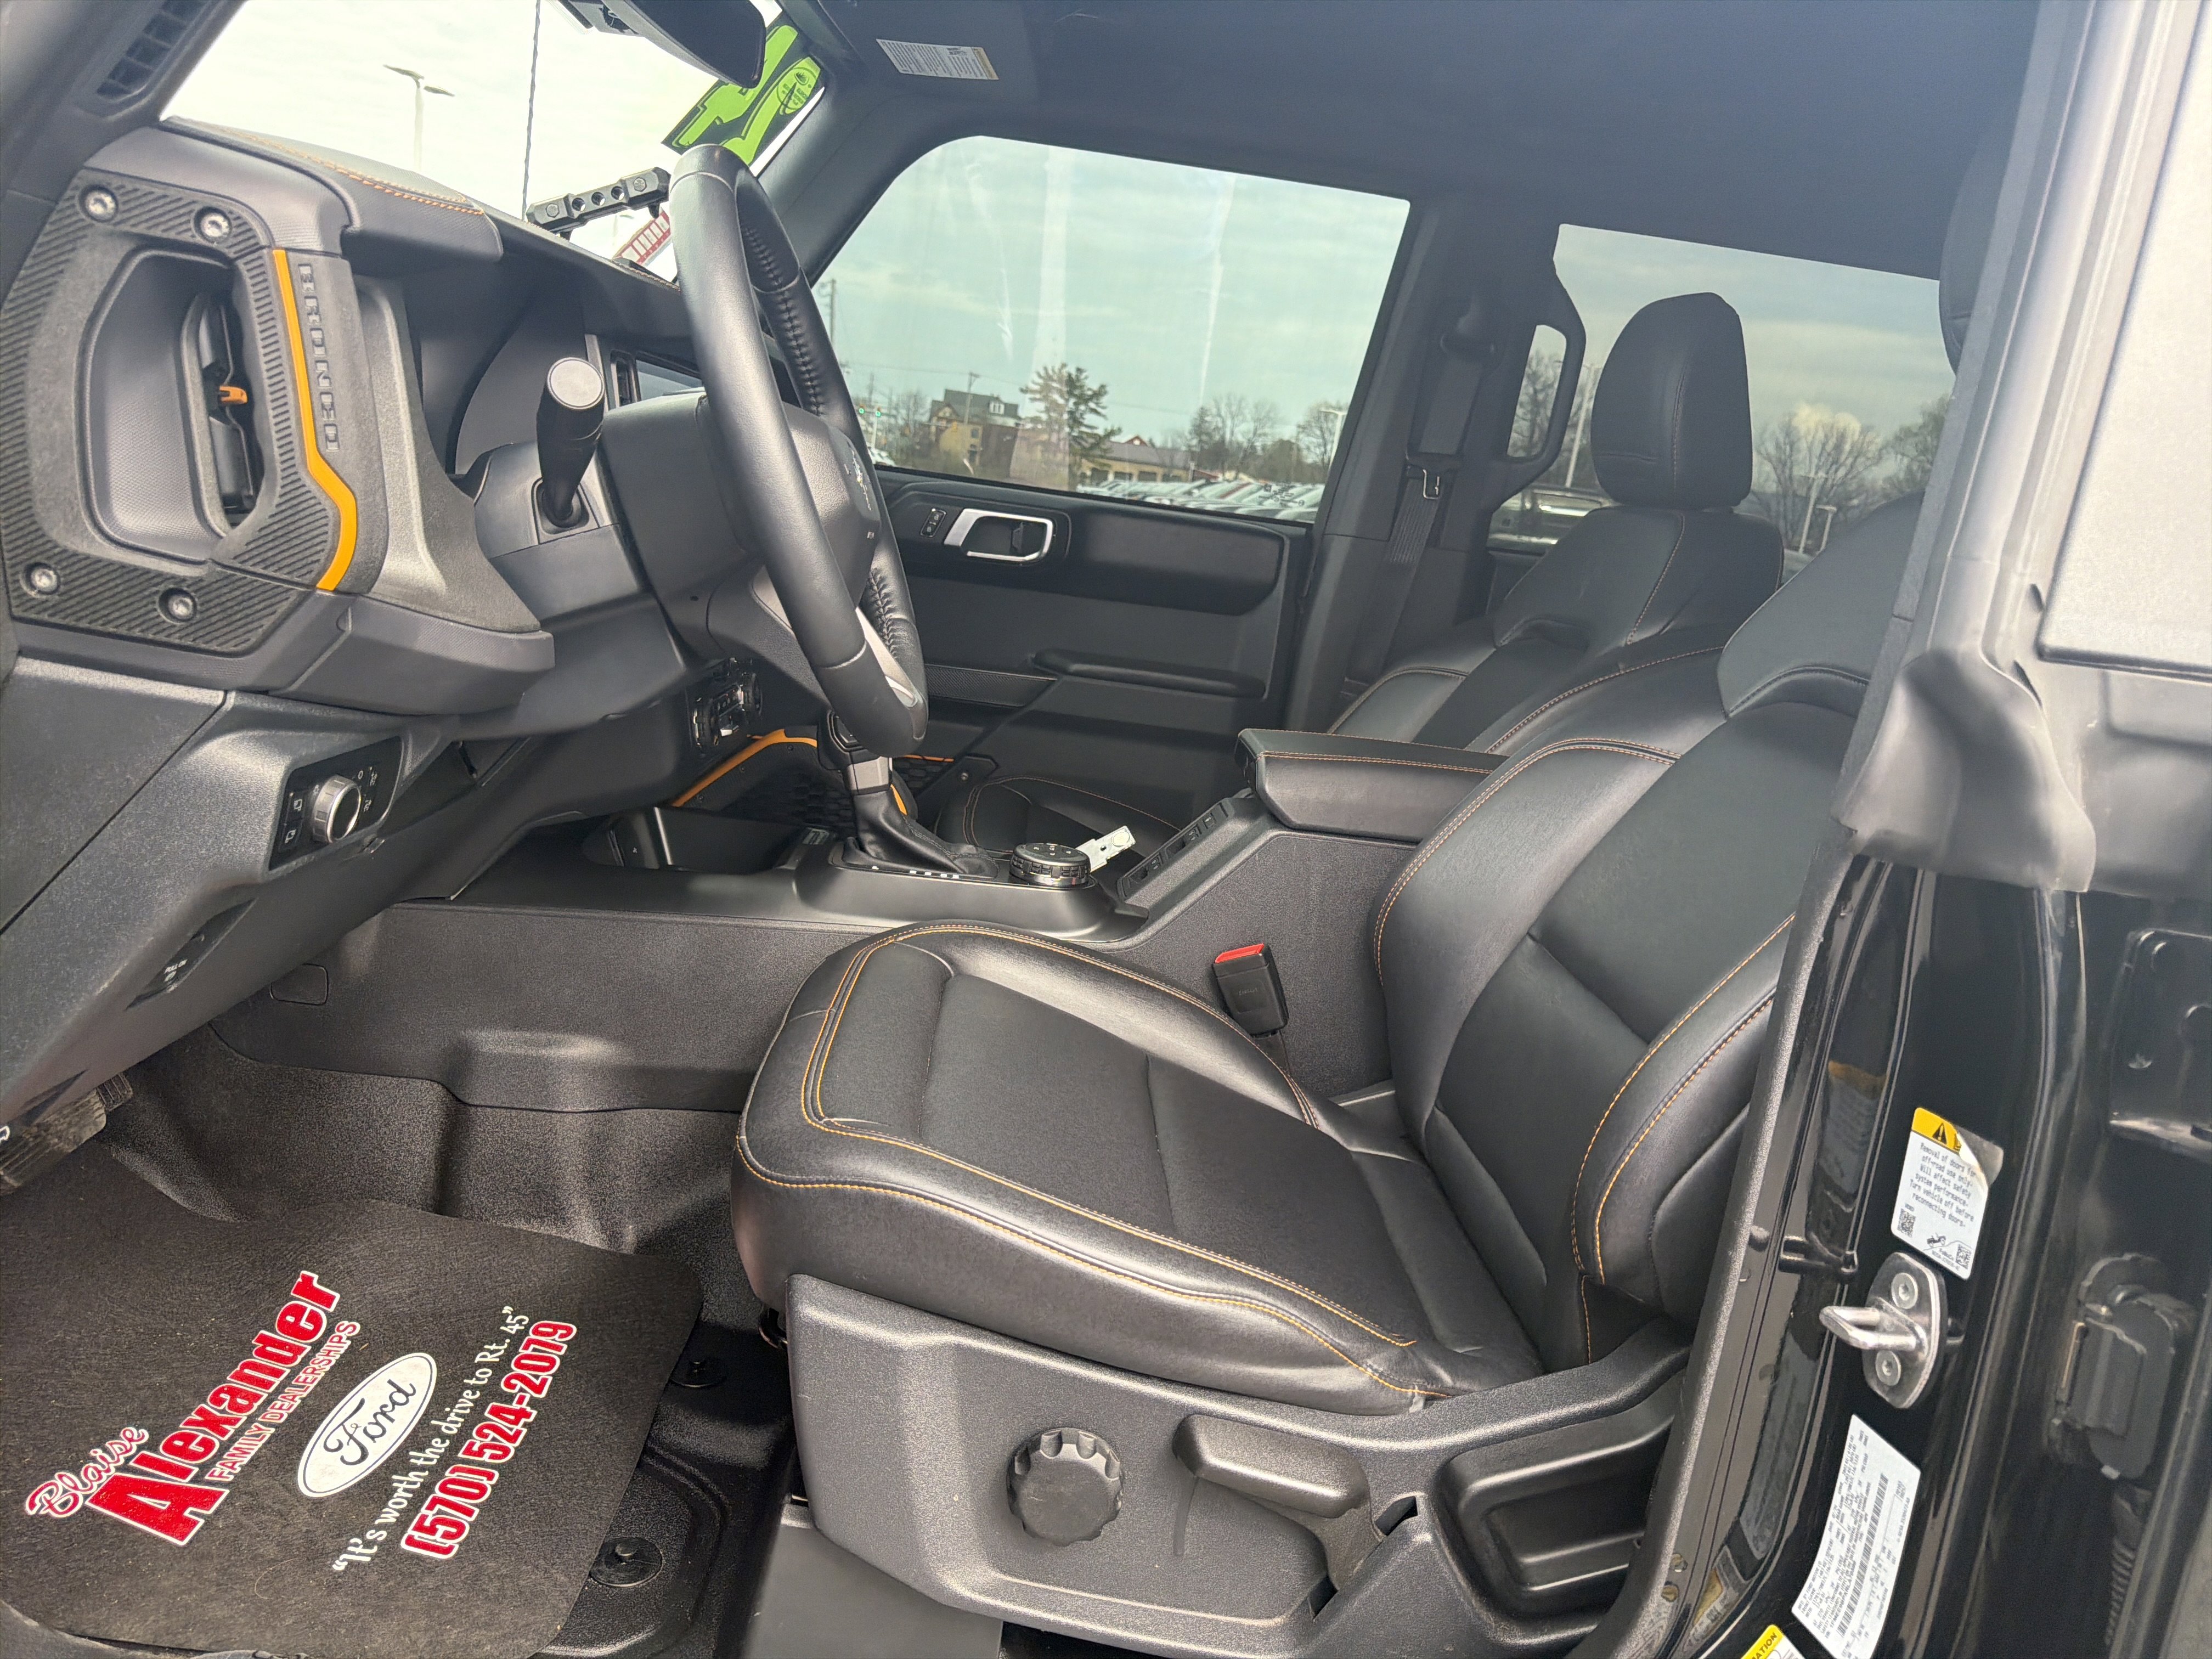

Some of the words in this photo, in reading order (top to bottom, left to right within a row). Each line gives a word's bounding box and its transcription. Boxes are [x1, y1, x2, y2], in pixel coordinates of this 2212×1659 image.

[464, 1367, 492, 1384] to
[475, 1338, 510, 1362] Rt.
[85, 1269, 341, 1546] Alexander
[207, 1417, 275, 1481] FAMILY
[262, 1321, 361, 1425] DEALERSHIPS
[324, 1379, 416, 1465] Ford
[431, 1387, 481, 1434] drive
[26, 1426, 149, 1519] Blaise
[400, 1464, 500, 1559] (570)
[459, 1321, 577, 1463] 524-2079
[409, 1437, 450, 1465] the
[375, 1470, 428, 1525] worth
